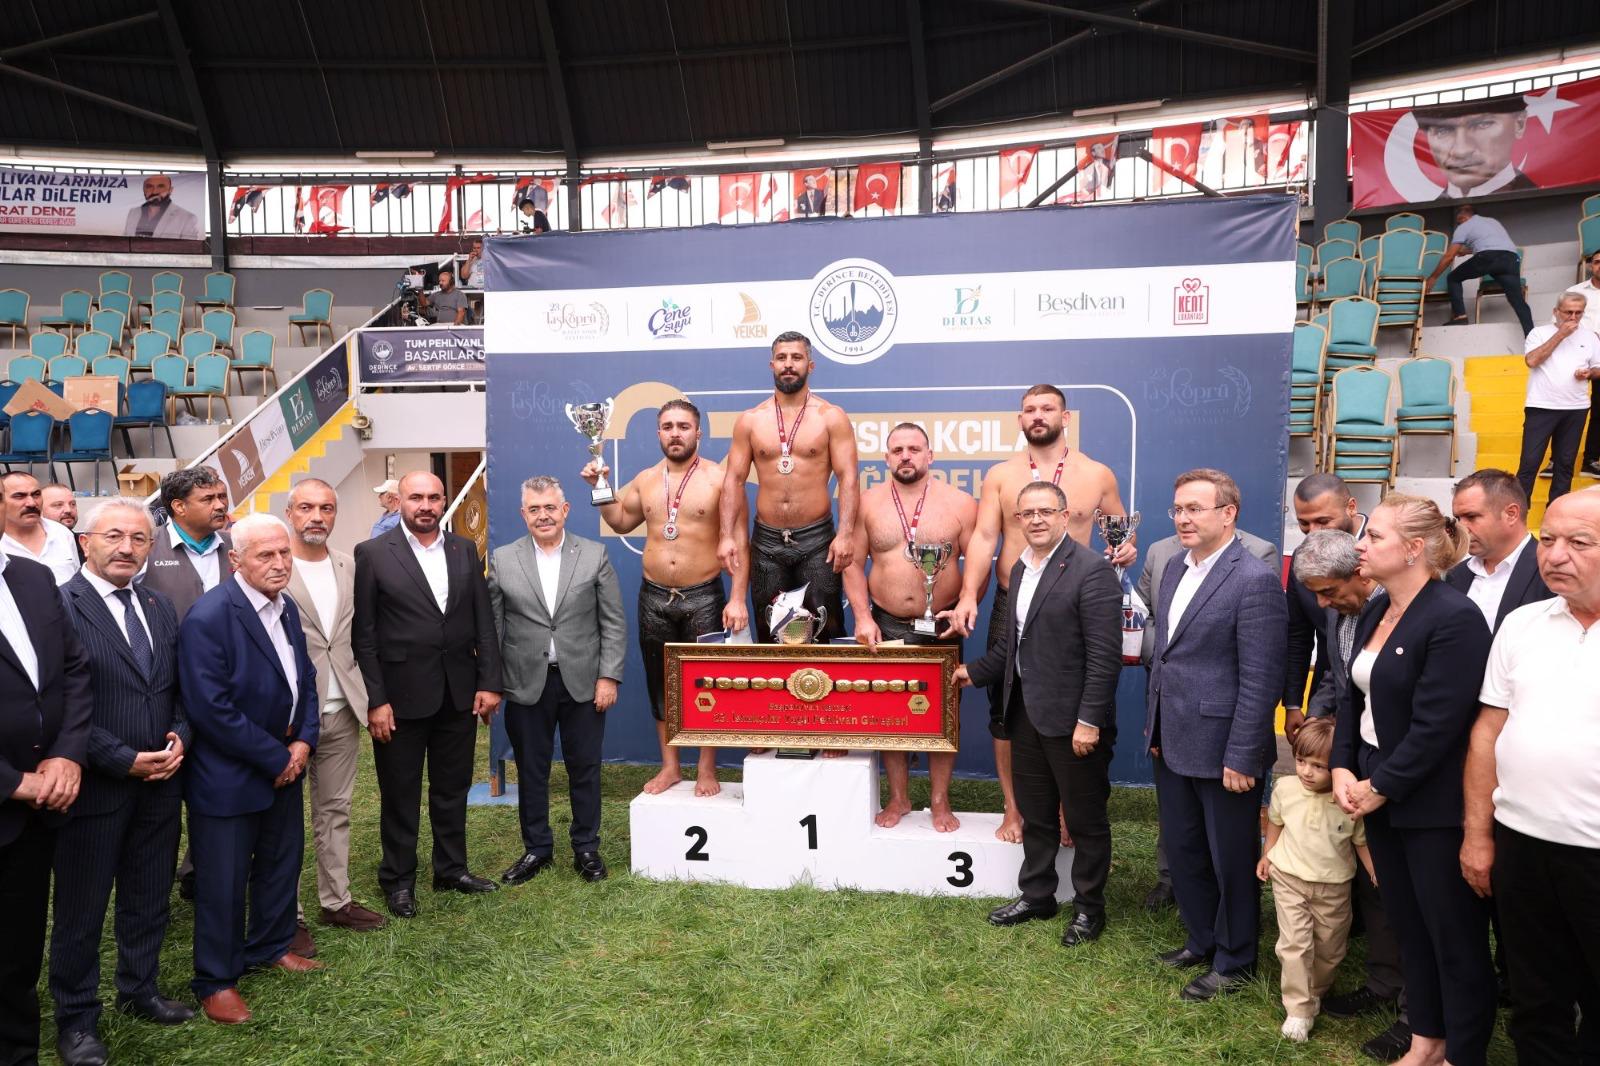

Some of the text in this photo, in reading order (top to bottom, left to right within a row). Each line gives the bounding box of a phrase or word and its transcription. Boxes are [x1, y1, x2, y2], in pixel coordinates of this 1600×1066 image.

[32, 206, 76, 217] DENİZ
[1037, 291, 1126, 314] Beşdivan
[1178, 295, 1205, 313] KENT
[664, 316, 692, 334] suyu
[733, 324, 769, 340] YELKEN
[404, 348, 475, 362] BAŞARILAR
[844, 345, 864, 353] 1994
[799, 814, 818, 850] 1
[684, 825, 710, 861] 2
[946, 851, 974, 888] 3
